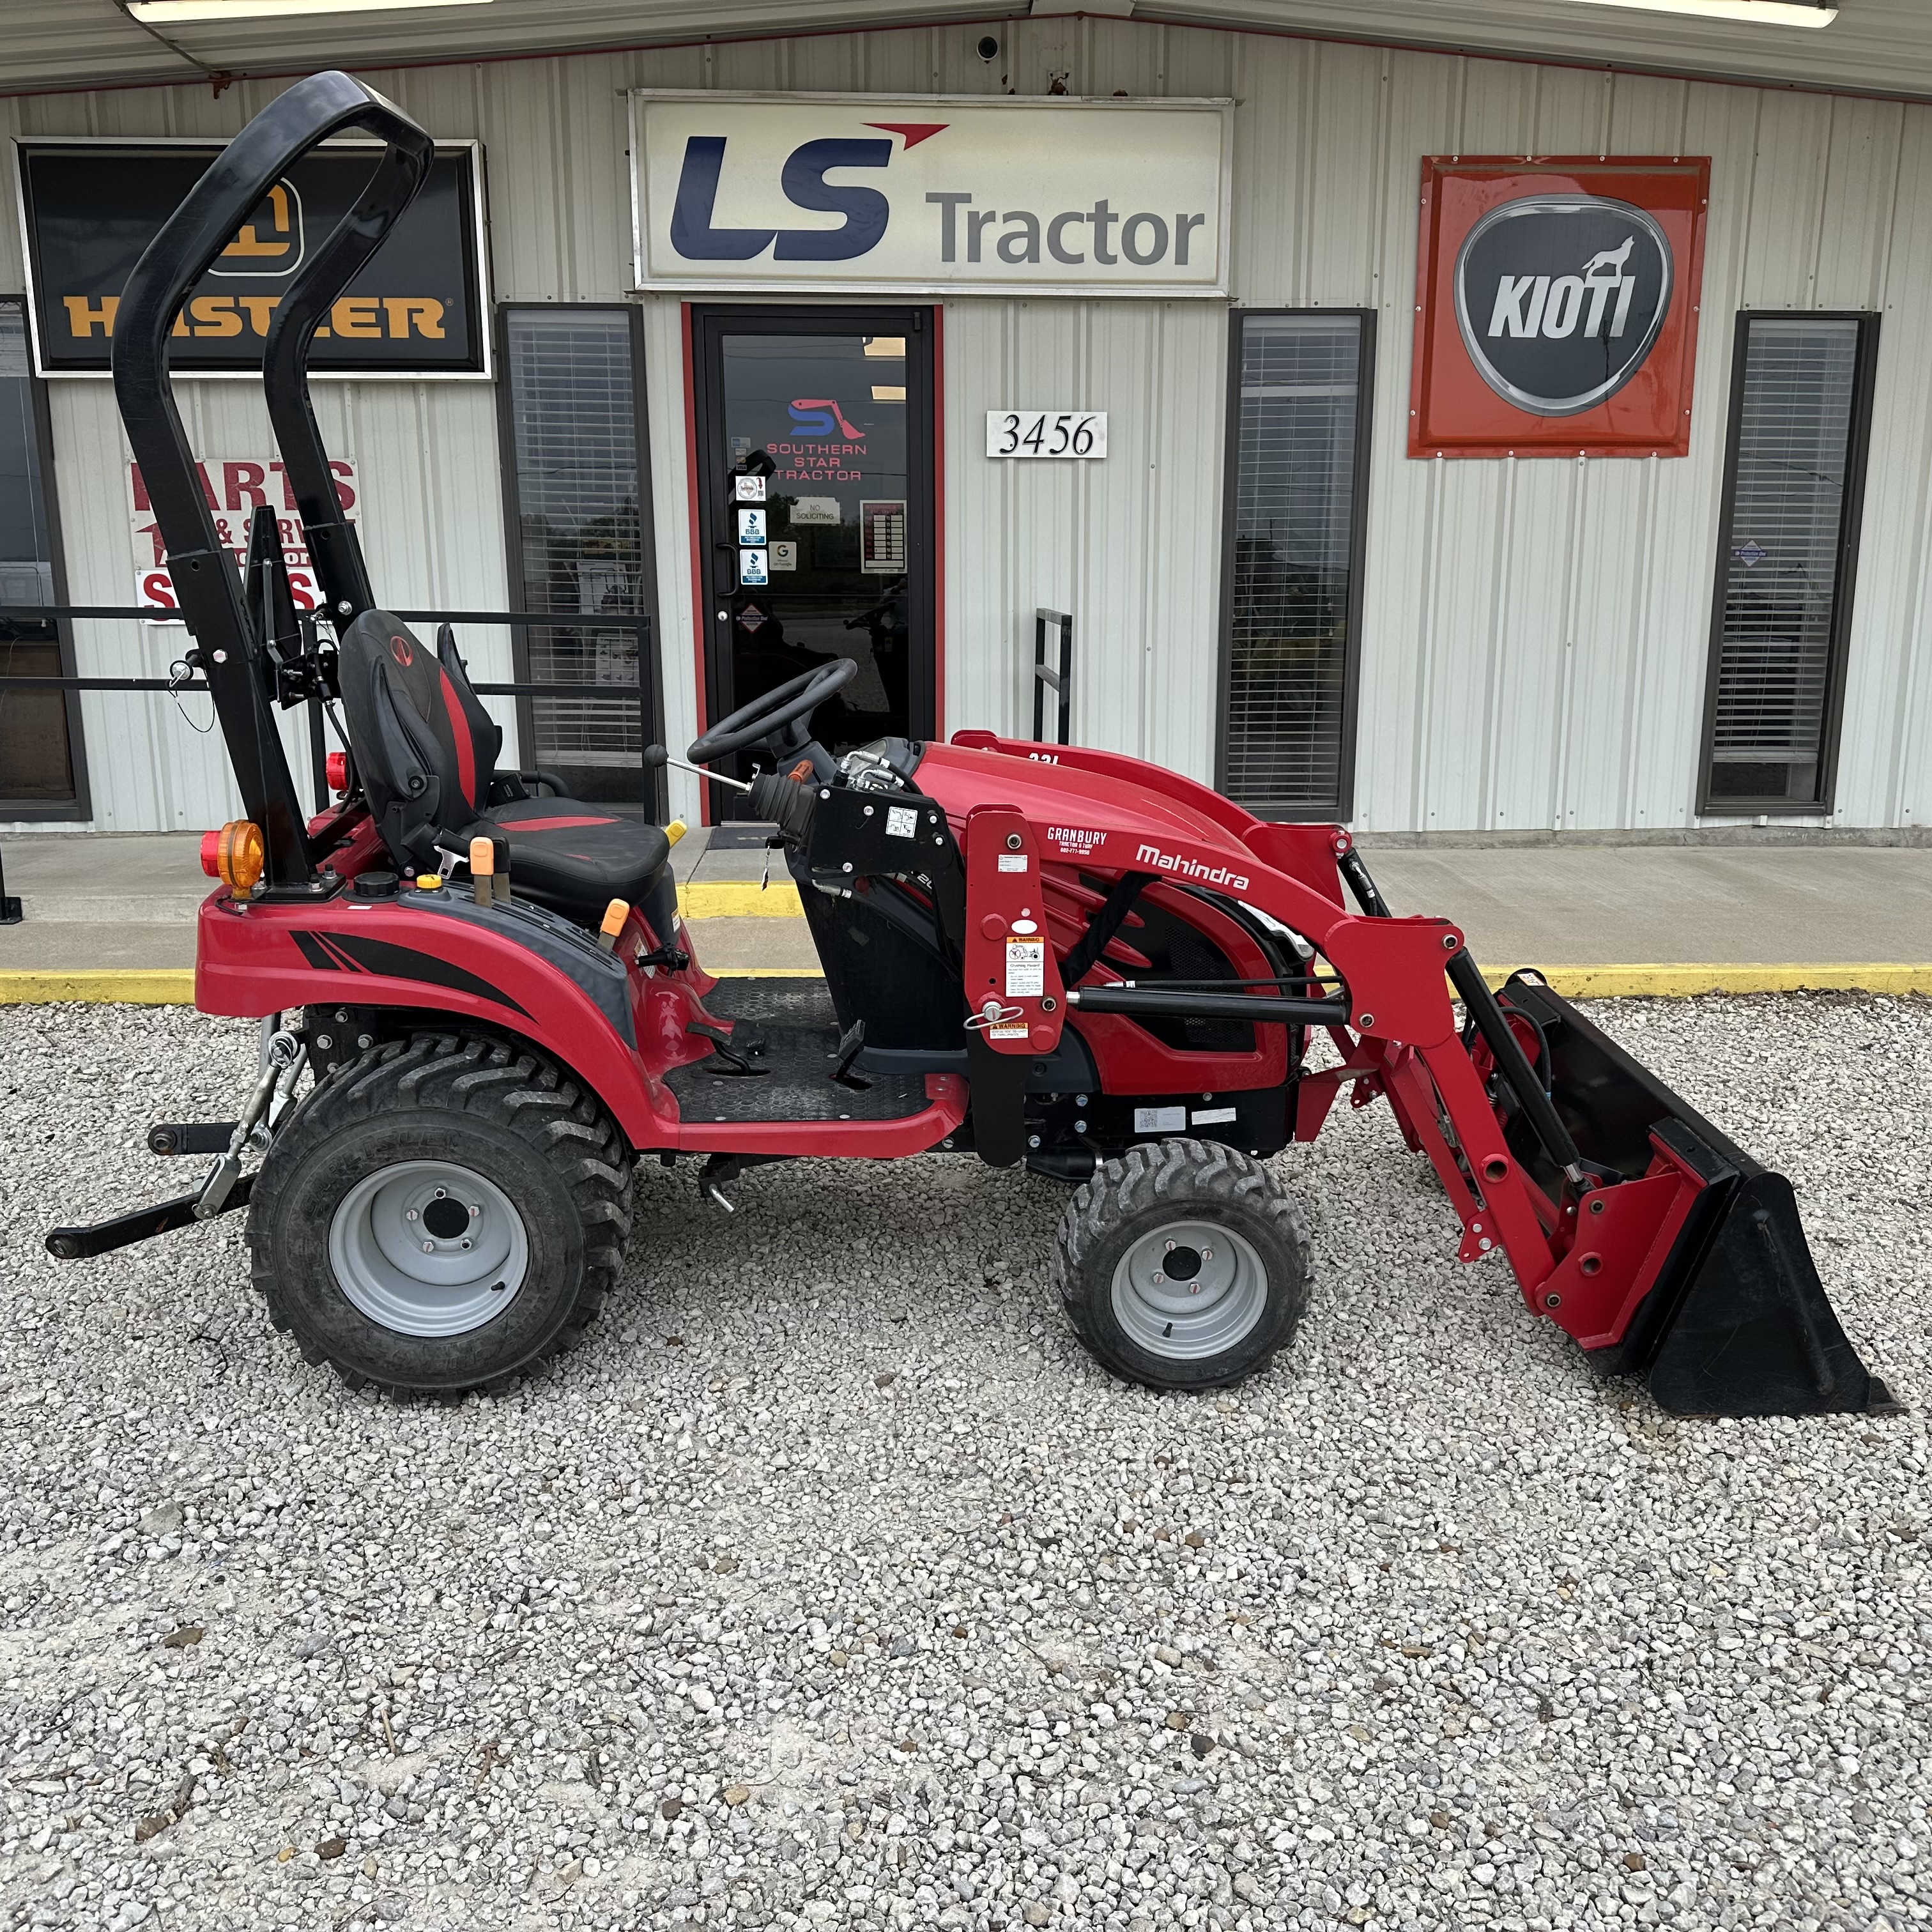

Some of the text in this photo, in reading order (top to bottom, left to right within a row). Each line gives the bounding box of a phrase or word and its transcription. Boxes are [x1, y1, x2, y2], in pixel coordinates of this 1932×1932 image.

[669, 135, 1206, 266] LS Tractor
[63, 296, 446, 339] HSTER
[1487, 275, 1636, 339] KIOTI
[767, 443, 867, 455] SOUTHERN
[999, 414, 1096, 456] 3456
[774, 470, 861, 481] TRACTOR
[794, 457, 841, 468] STAR
[1048, 827, 1107, 845] GRANBURY
[1135, 844, 1250, 891] Mahindra
